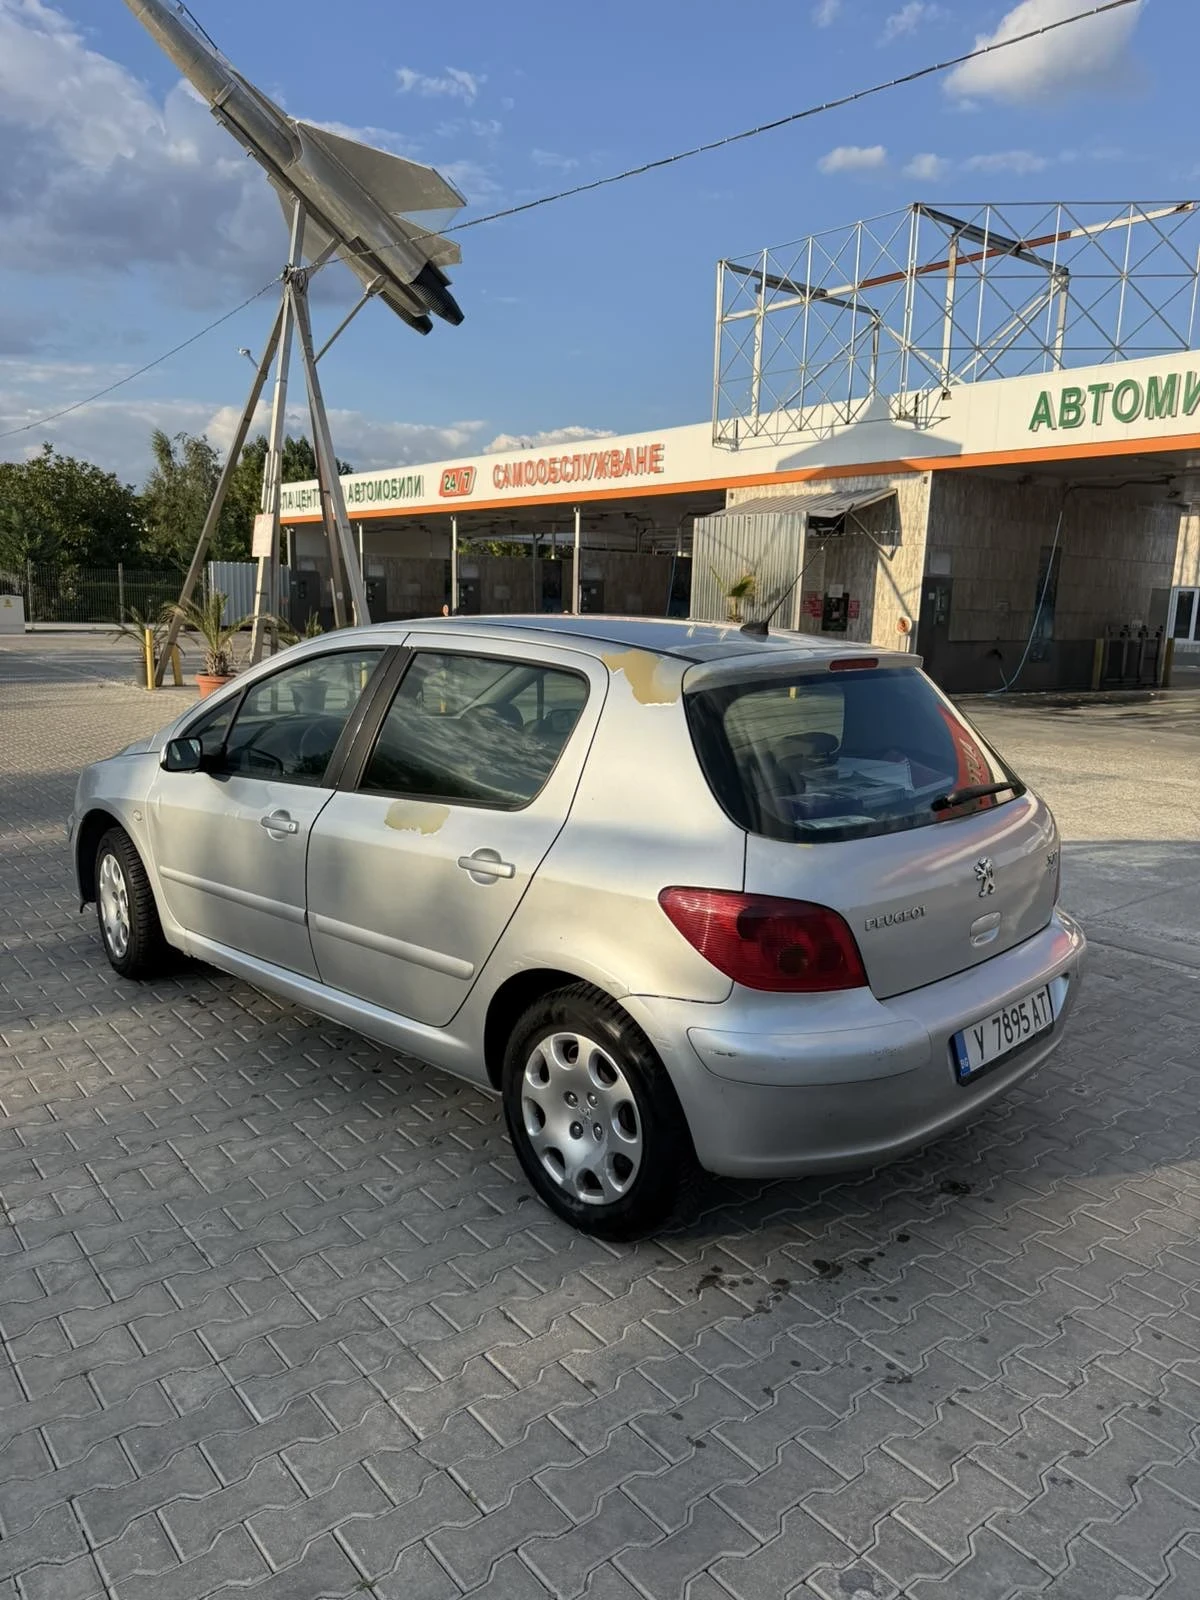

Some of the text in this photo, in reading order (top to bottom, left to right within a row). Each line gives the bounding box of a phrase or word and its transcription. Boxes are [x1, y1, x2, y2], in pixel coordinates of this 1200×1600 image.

[444, 471, 471, 491] 24/7
[492, 444, 664, 489] САМООБСЛУЖВАНЕ
[295, 488, 321, 511] ЦЕНТ
[348, 476, 423, 503] АВТОМОБИЛИ
[864, 904, 927, 931] PEUGEOT
[992, 1003, 1030, 1050] 7895
